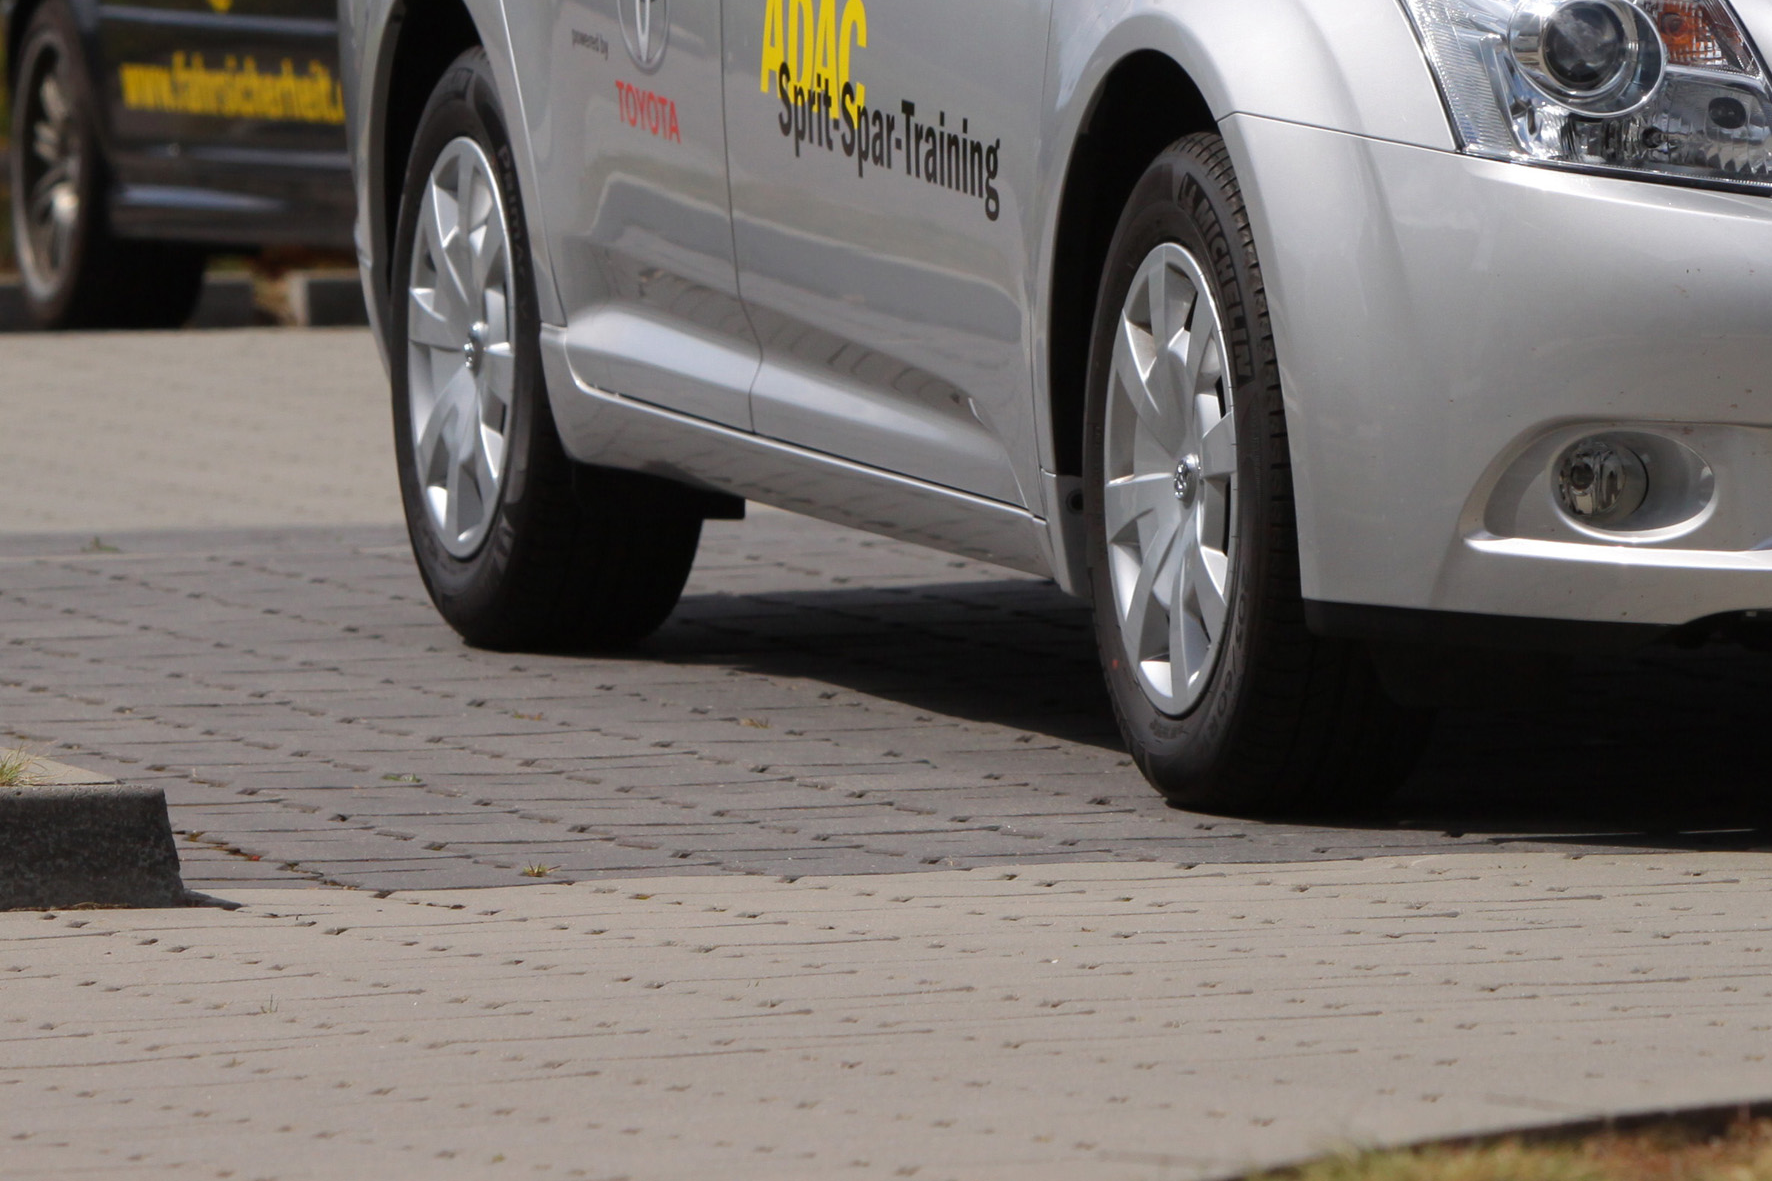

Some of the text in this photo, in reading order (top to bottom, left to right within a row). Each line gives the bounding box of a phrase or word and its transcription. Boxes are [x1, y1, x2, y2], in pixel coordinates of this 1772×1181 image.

[121, 50, 346, 123] www.fahrsicherheit.
[615, 80, 681, 144] TOYOTA
[778, 60, 1000, 221] Sprit-Spar-Training
[1195, 196, 1254, 377] MICHELIN
